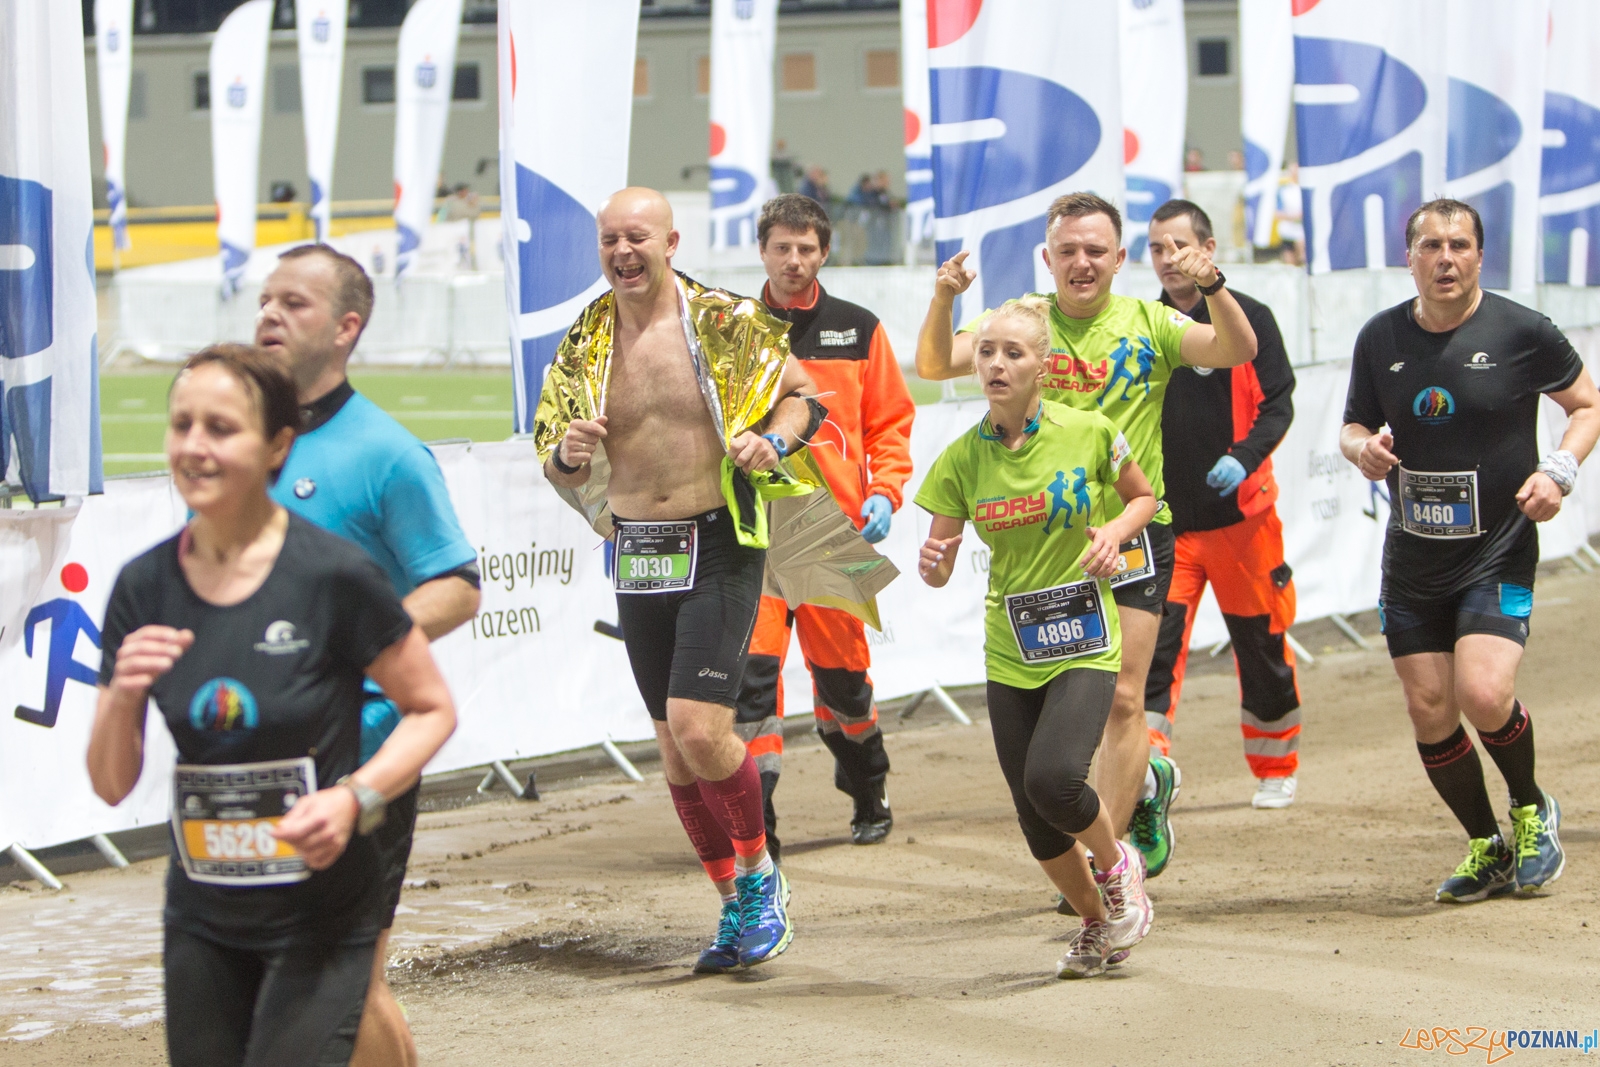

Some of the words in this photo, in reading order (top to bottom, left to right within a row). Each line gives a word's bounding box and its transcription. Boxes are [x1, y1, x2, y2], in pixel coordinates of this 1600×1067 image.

[1389, 362, 1405, 372] 4F
[975, 492, 1046, 522] CIDRY
[1413, 503, 1454, 525] 8460
[481, 541, 574, 591] iegajmy
[629, 556, 673, 578] 3030
[1037, 618, 1085, 646] 4896
[708, 670, 729, 680] asics
[203, 821, 278, 858] 5626
